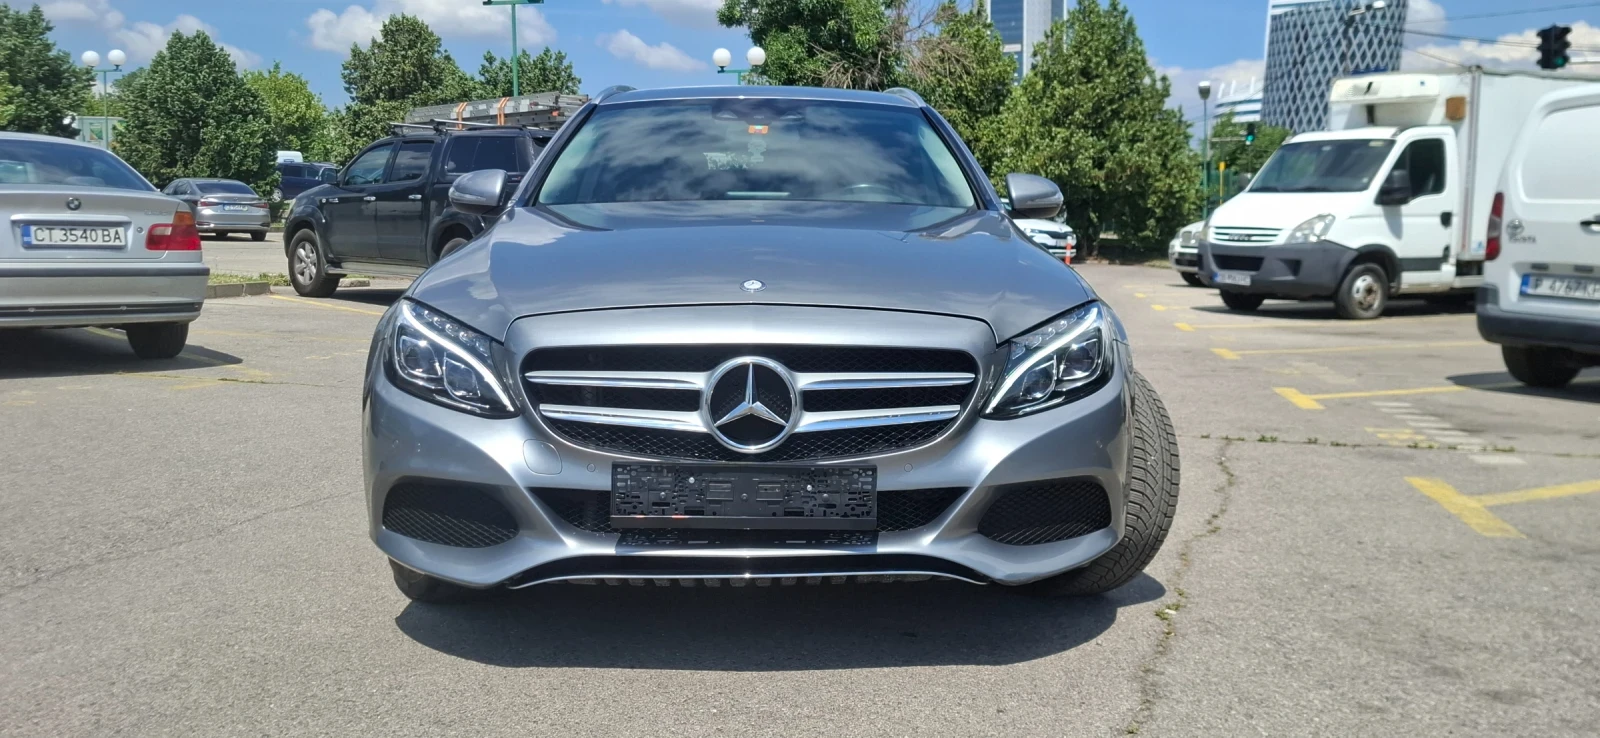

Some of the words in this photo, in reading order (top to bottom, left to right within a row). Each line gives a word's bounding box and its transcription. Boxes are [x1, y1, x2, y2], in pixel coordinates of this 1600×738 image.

[33, 227, 55, 242] CT
[59, 228, 98, 242] 3540
[101, 229, 122, 243] BA
